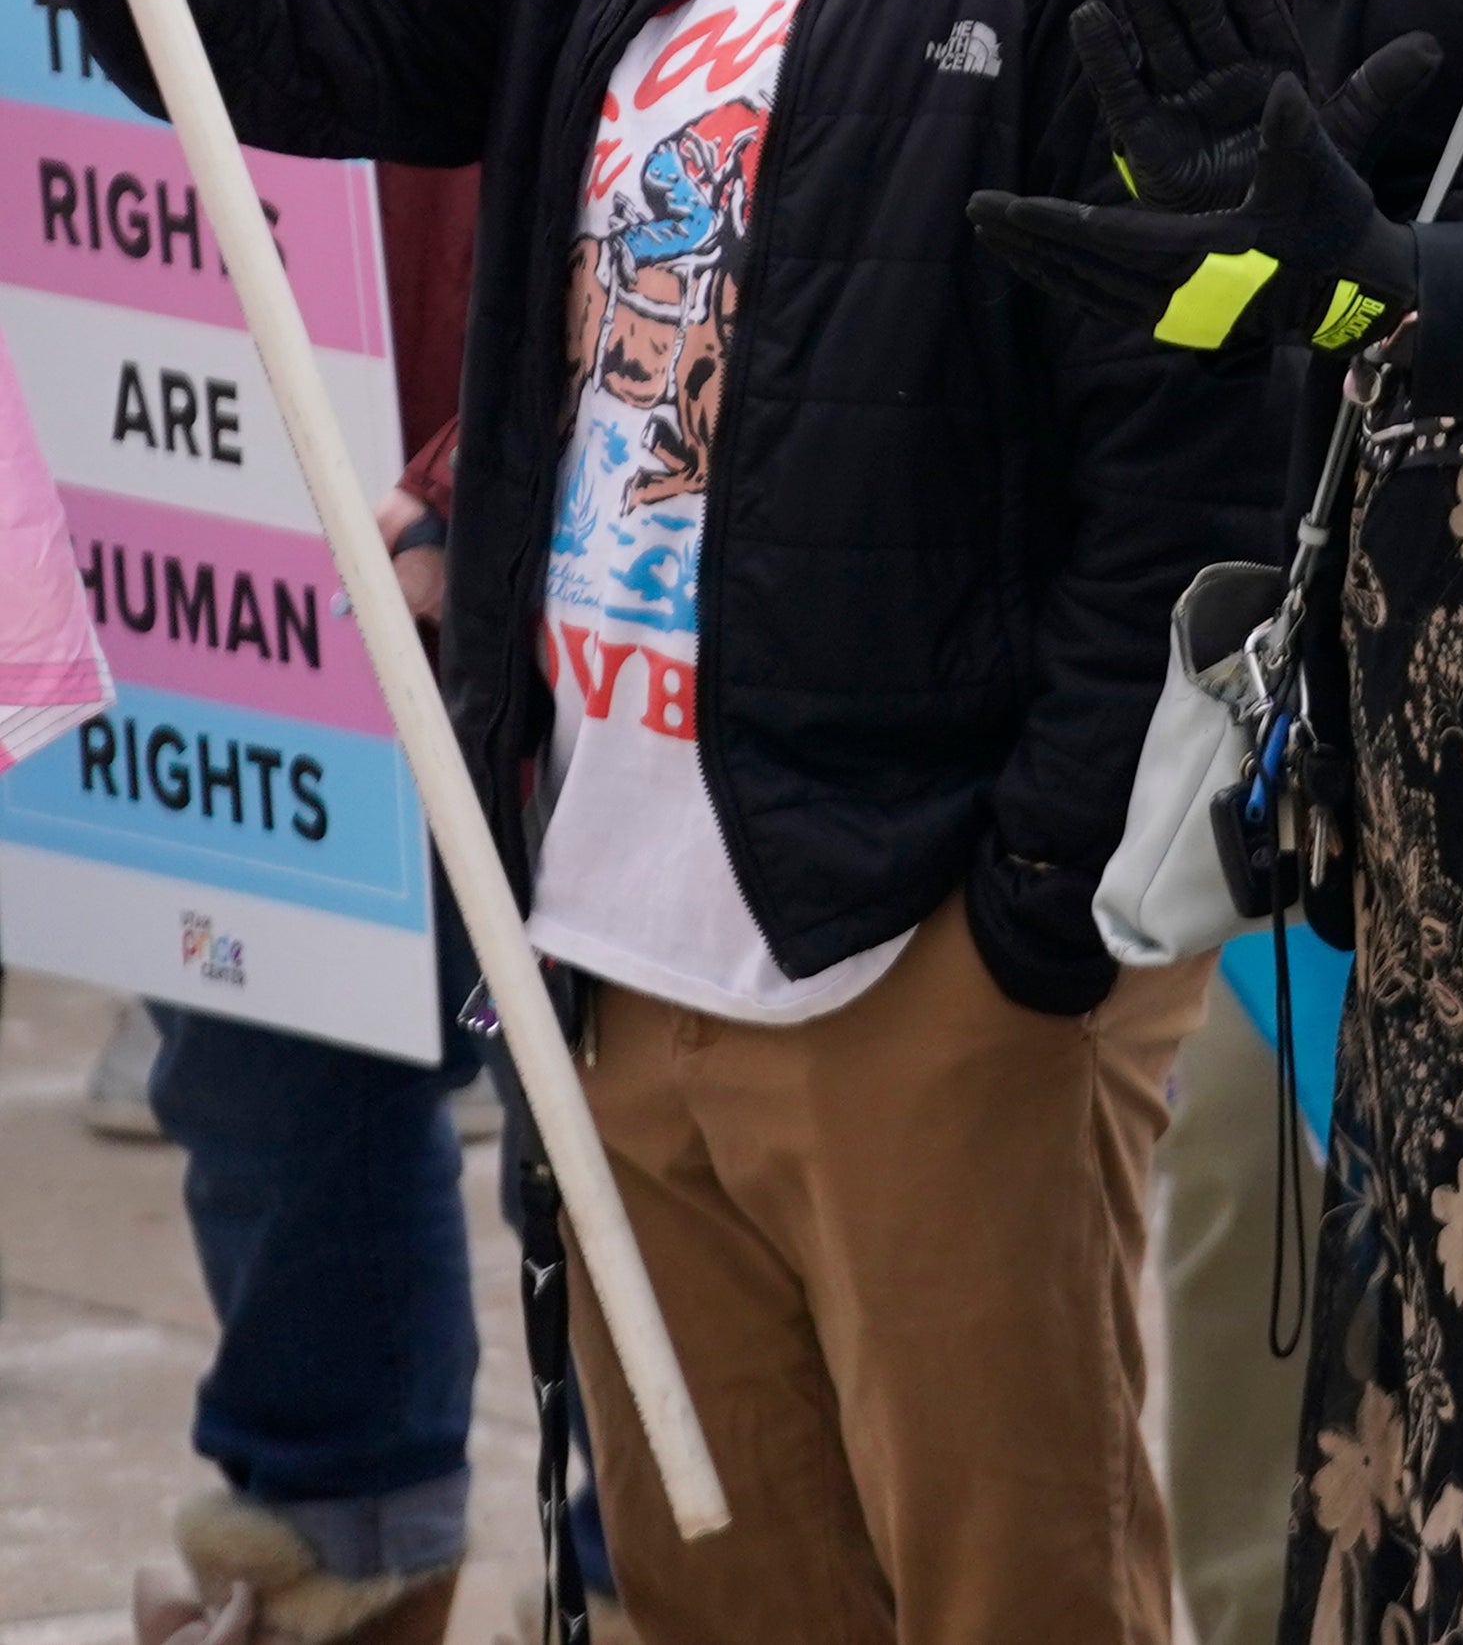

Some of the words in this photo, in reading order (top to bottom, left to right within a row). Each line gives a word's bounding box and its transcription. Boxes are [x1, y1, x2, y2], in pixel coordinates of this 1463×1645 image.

[37, 157, 288, 280] RIGH
[112, 359, 243, 467] ARE
[78, 711, 329, 843] RIGHTS
